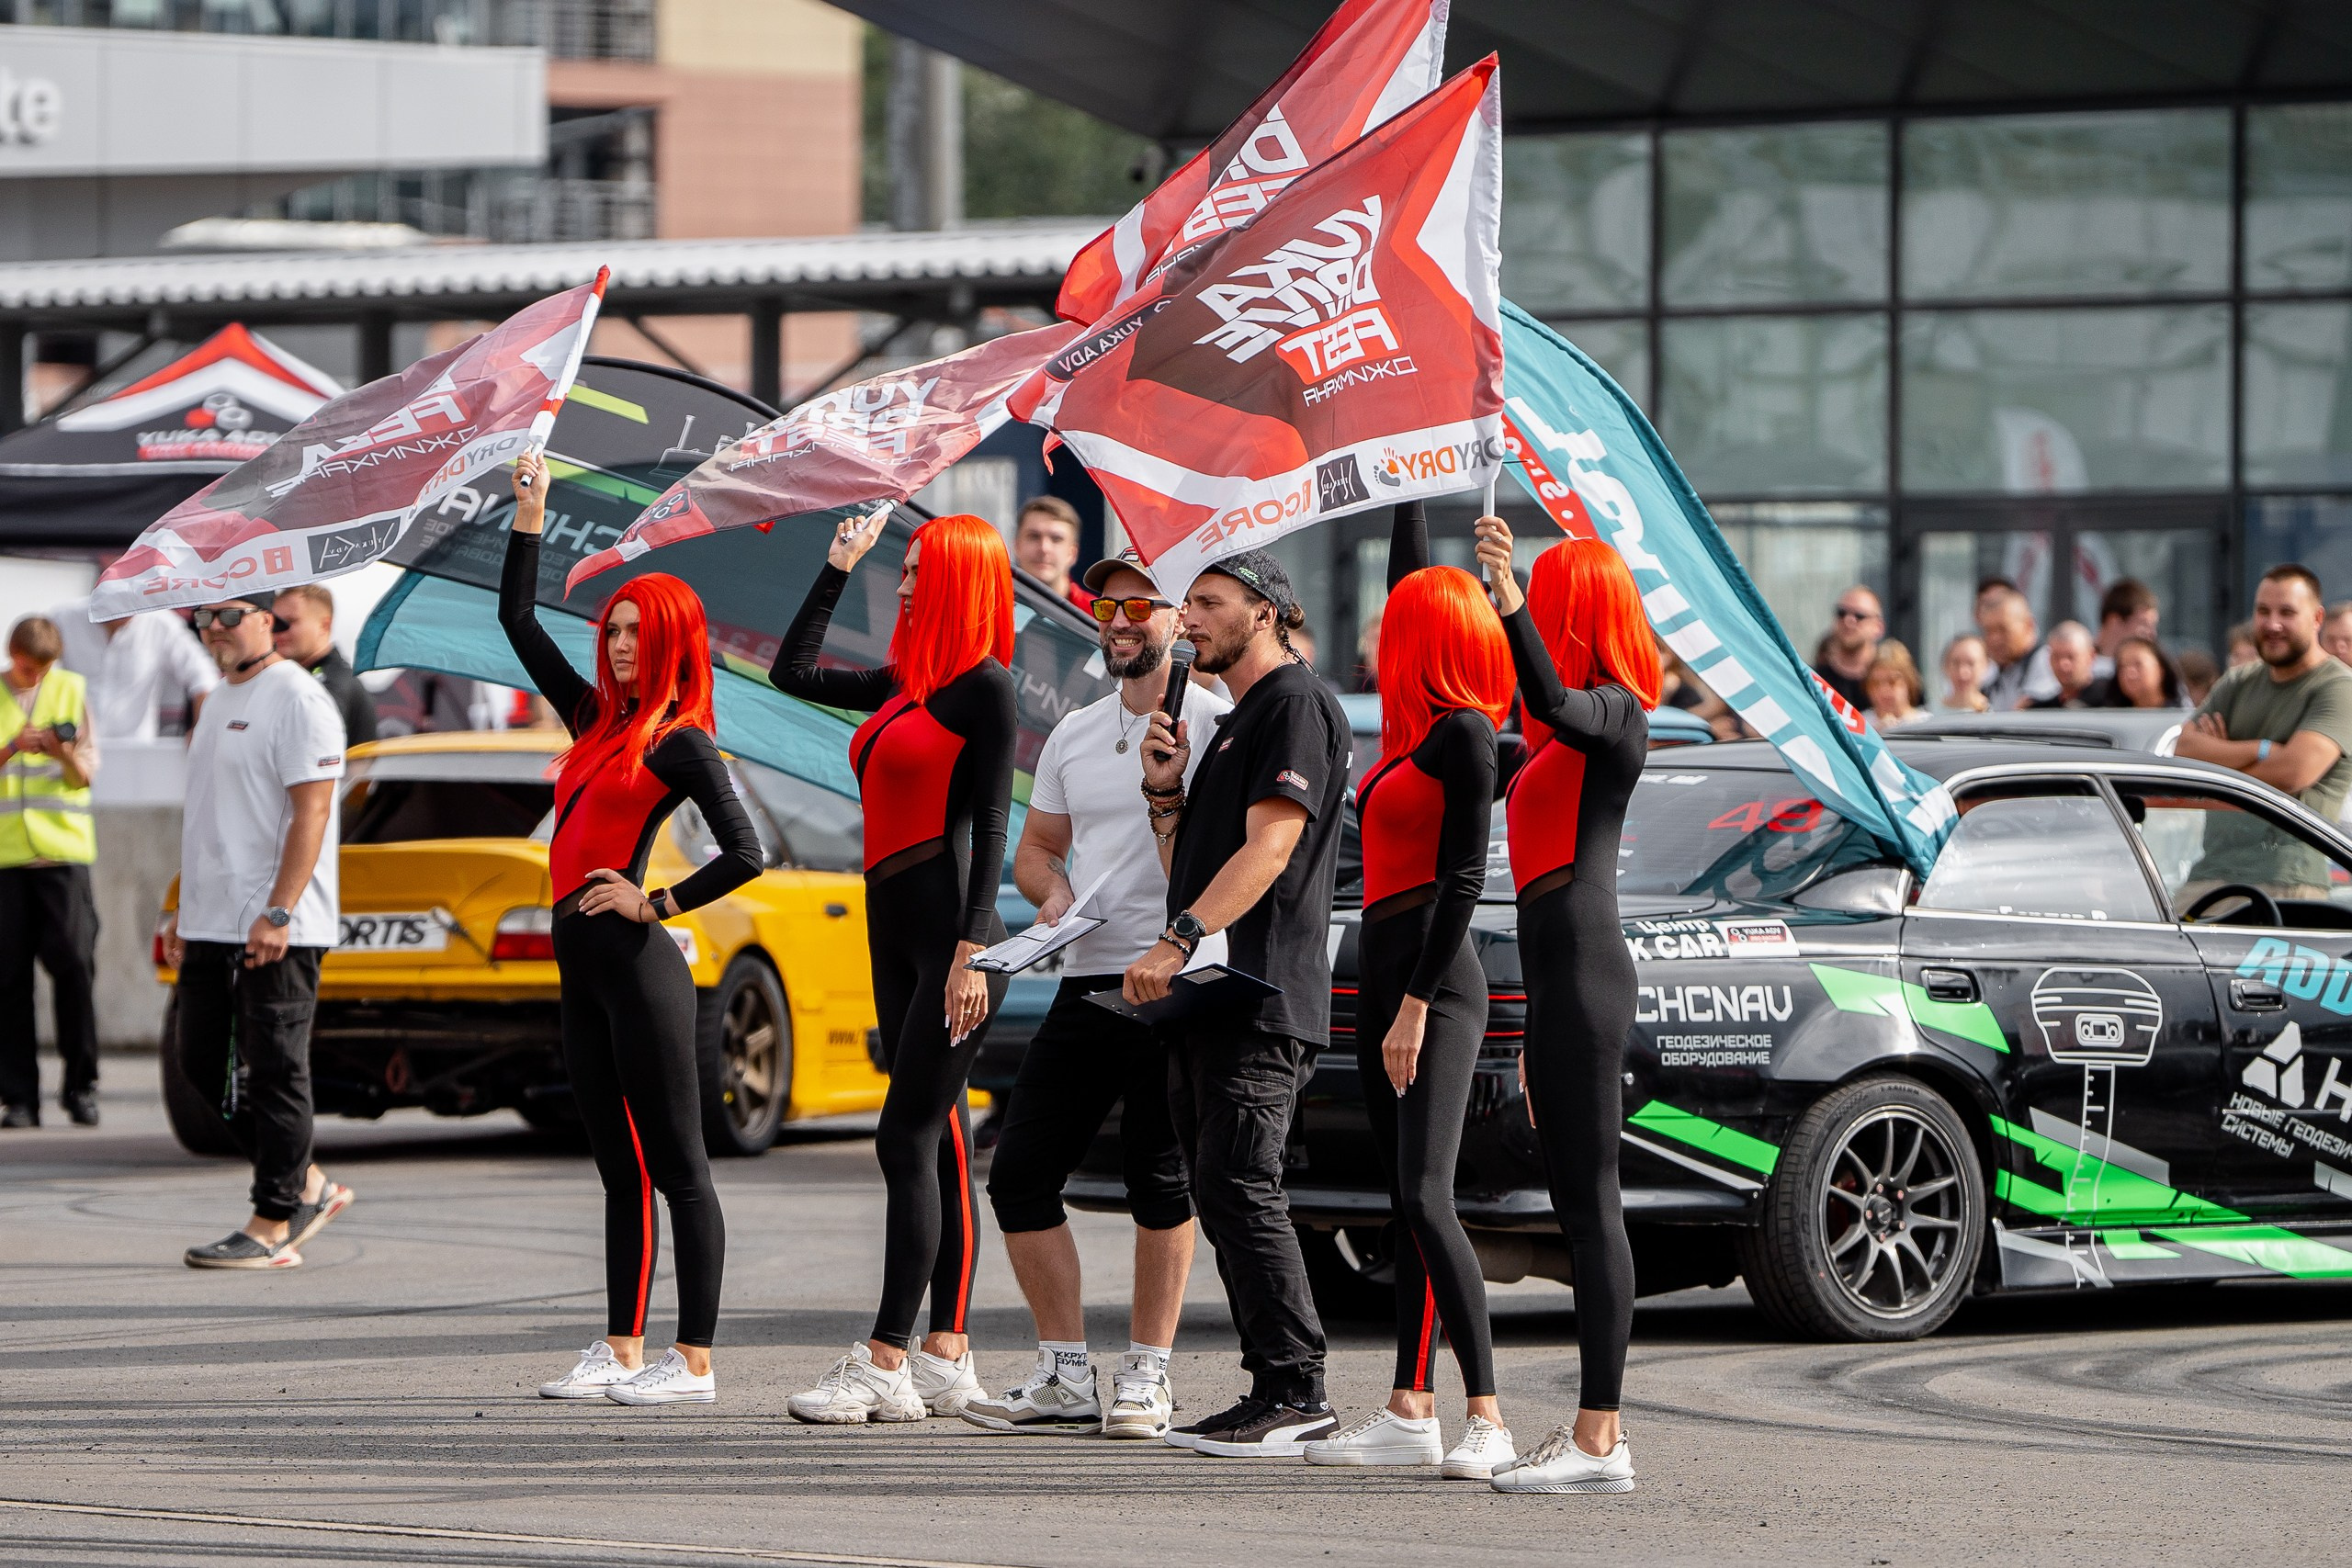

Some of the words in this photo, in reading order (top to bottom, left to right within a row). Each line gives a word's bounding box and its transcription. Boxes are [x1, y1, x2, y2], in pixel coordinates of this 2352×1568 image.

[1707, 797, 1825, 832] 49
[1636, 919, 1711, 935] Центр
[1635, 985, 1795, 1023] CHCNAV
[1657, 1034, 1773, 1049] ГЕОДЕЗИЧЕСКОЕ
[1661, 1051, 1770, 1067] ОБОРУДОВАНИЕ
[2221, 1113, 2296, 1158] СИСТЕМЫ
[2229, 1091, 2287, 1129] НОВЫЕ
[2284, 1116, 2352, 1164] ГЕОДЕЗИ
